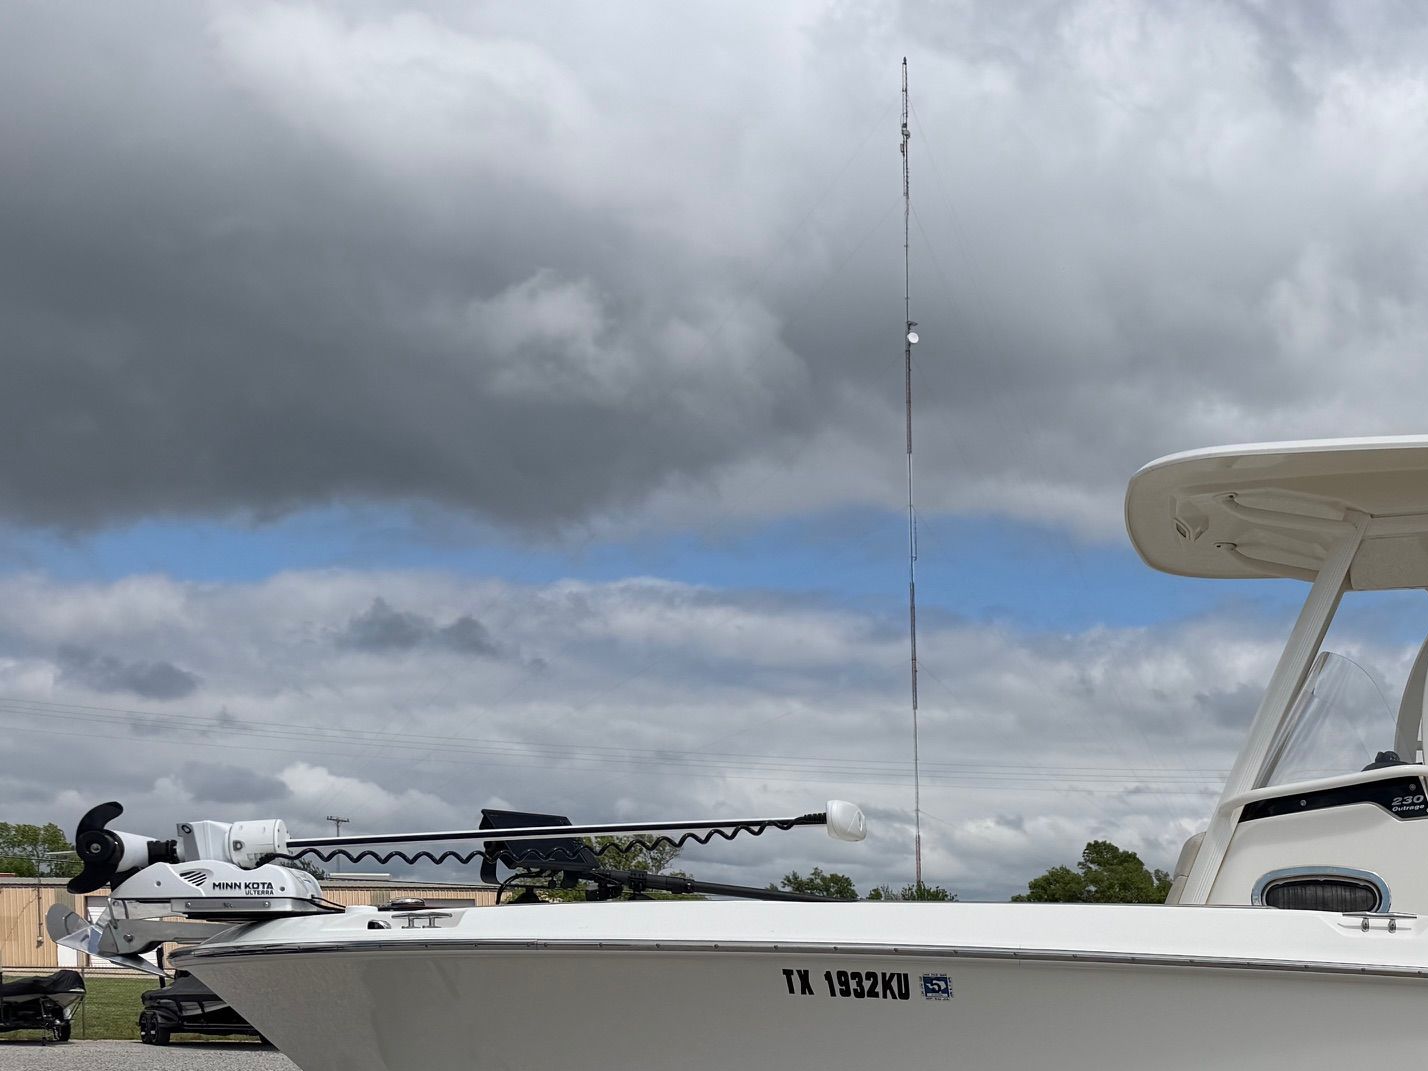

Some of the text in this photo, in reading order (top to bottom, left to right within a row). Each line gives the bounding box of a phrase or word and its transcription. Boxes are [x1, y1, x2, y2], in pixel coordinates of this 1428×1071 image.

[1391, 794, 1424, 806] 230
[1391, 804, 1425, 812] Outrage
[212, 881, 274, 890] MINN KOTA
[782, 968, 815, 996] TX
[823, 969, 911, 1001] 1932KU
